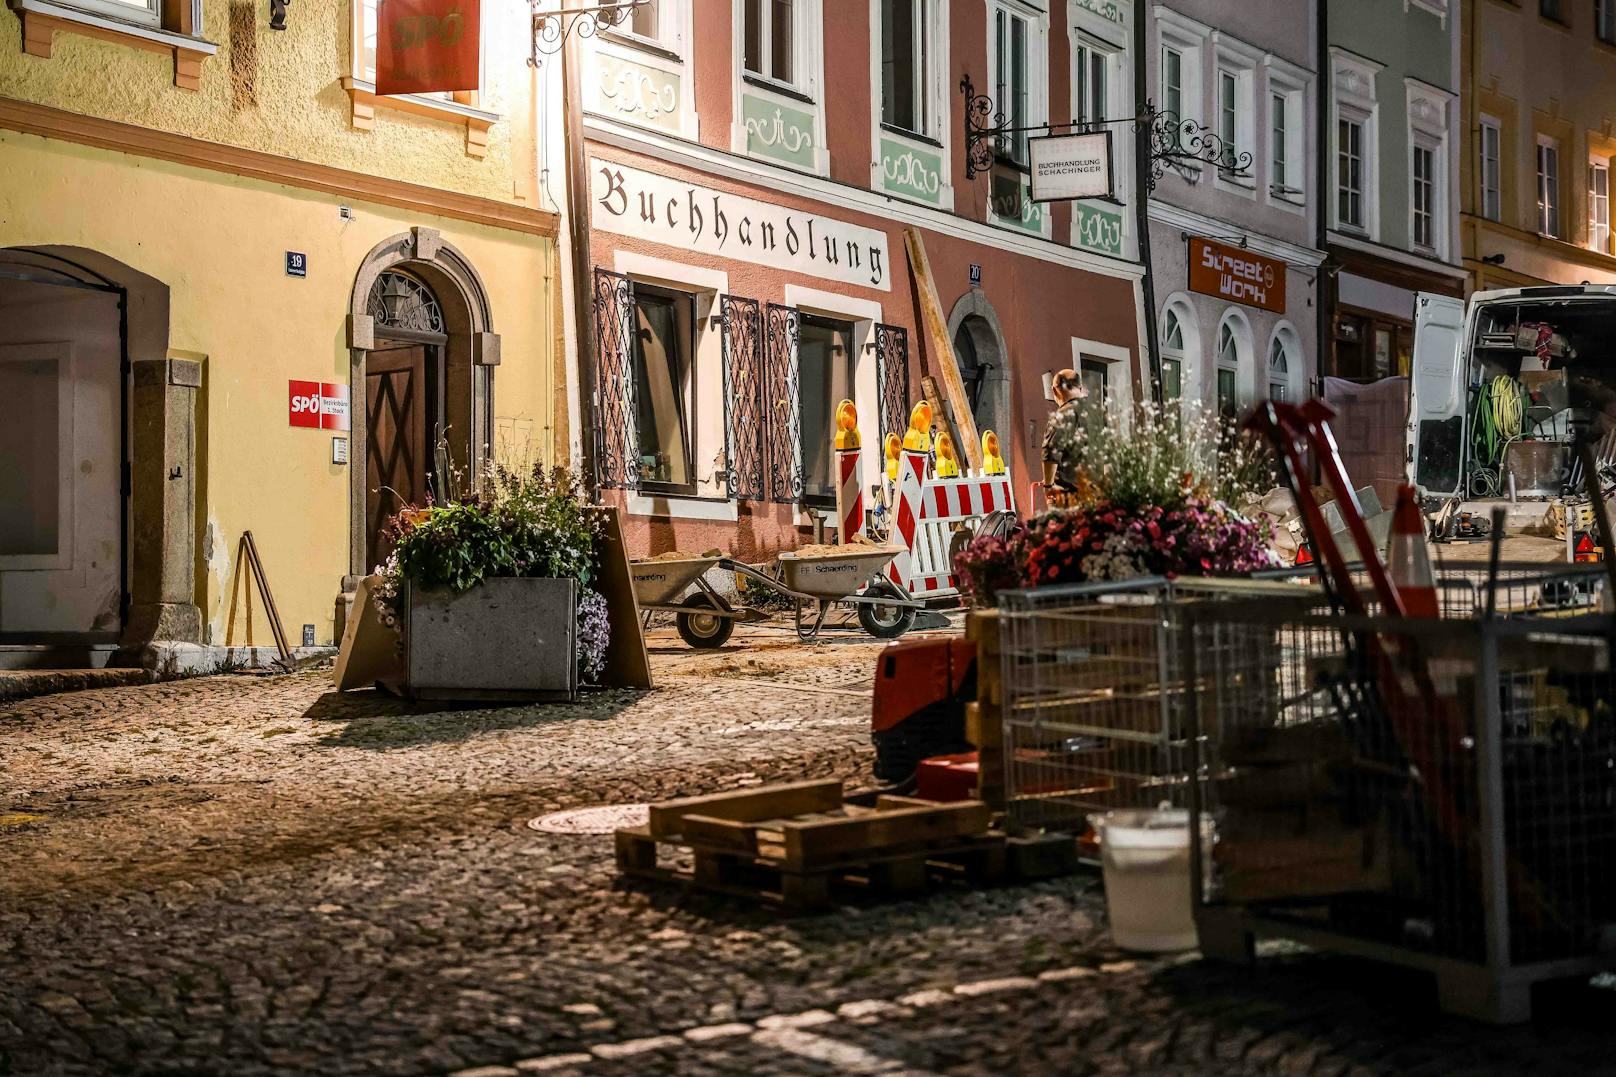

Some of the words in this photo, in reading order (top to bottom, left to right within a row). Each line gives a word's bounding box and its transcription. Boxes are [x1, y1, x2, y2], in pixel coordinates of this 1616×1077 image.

[391, 6, 464, 50] SPÖ
[1038, 158, 1101, 170] BUCHHANDLUNG
[1038, 166, 1101, 176] SCHACHINGER
[599, 166, 883, 285] Buchhandlung
[292, 255, 302, 267] 19
[1201, 246, 1264, 282] Street
[971, 265, 979, 279] 20
[1219, 273, 1266, 304] Work
[290, 394, 320, 413] SPÖ
[815, 564, 857, 574] Schaerding
